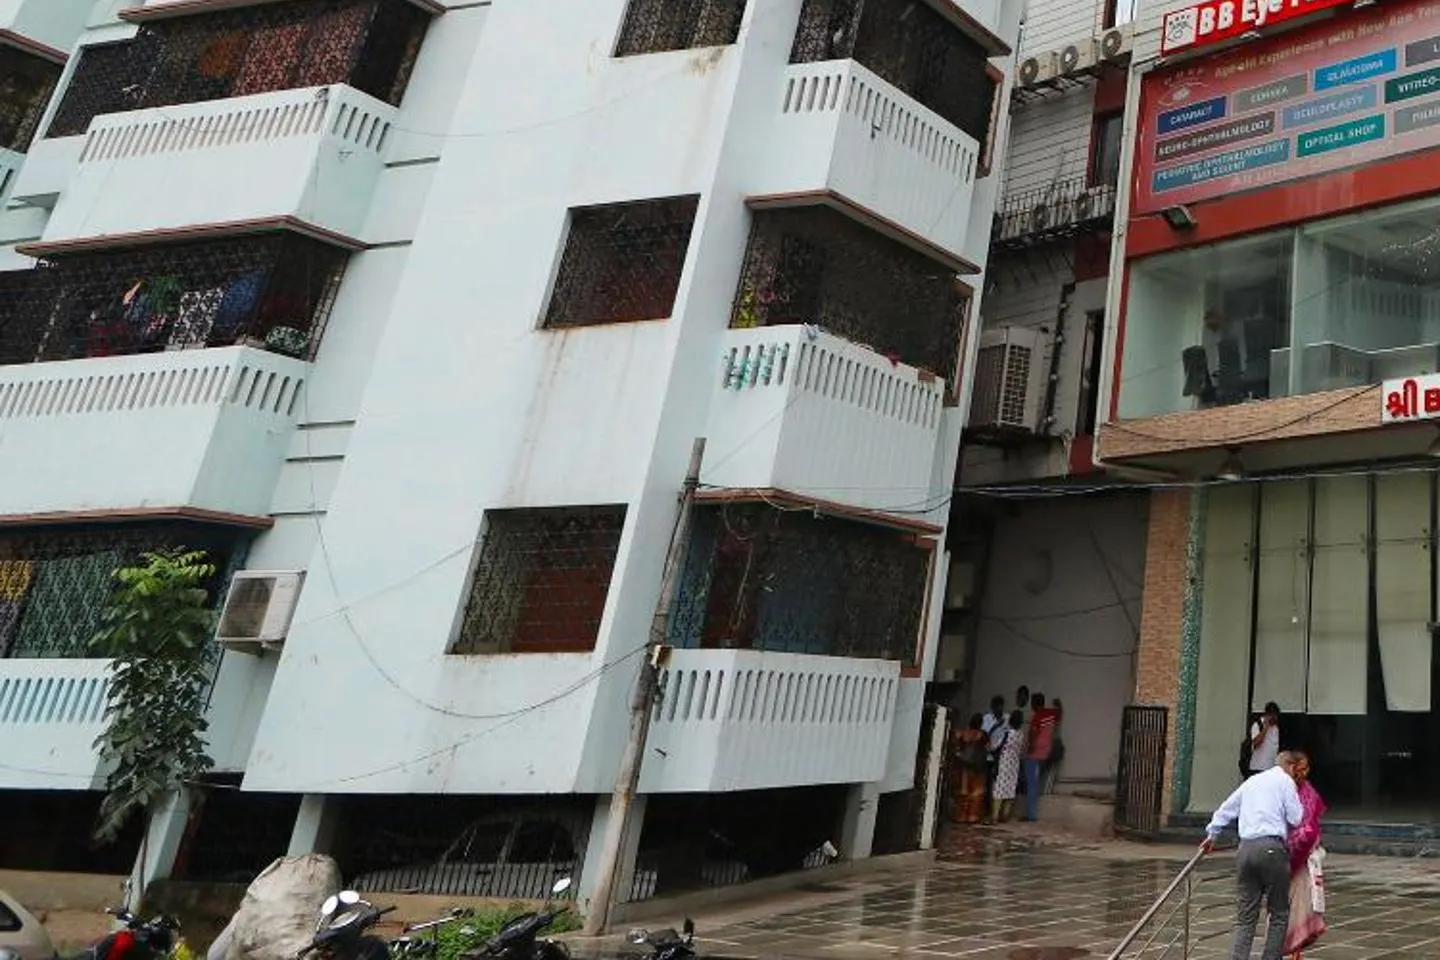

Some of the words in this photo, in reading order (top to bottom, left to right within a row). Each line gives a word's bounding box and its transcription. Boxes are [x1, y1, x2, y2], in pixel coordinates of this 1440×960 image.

[1305, 131, 1344, 149] OPTICAL
[1347, 123, 1378, 138] SHOP
[1386, 378, 1419, 418] श्री
